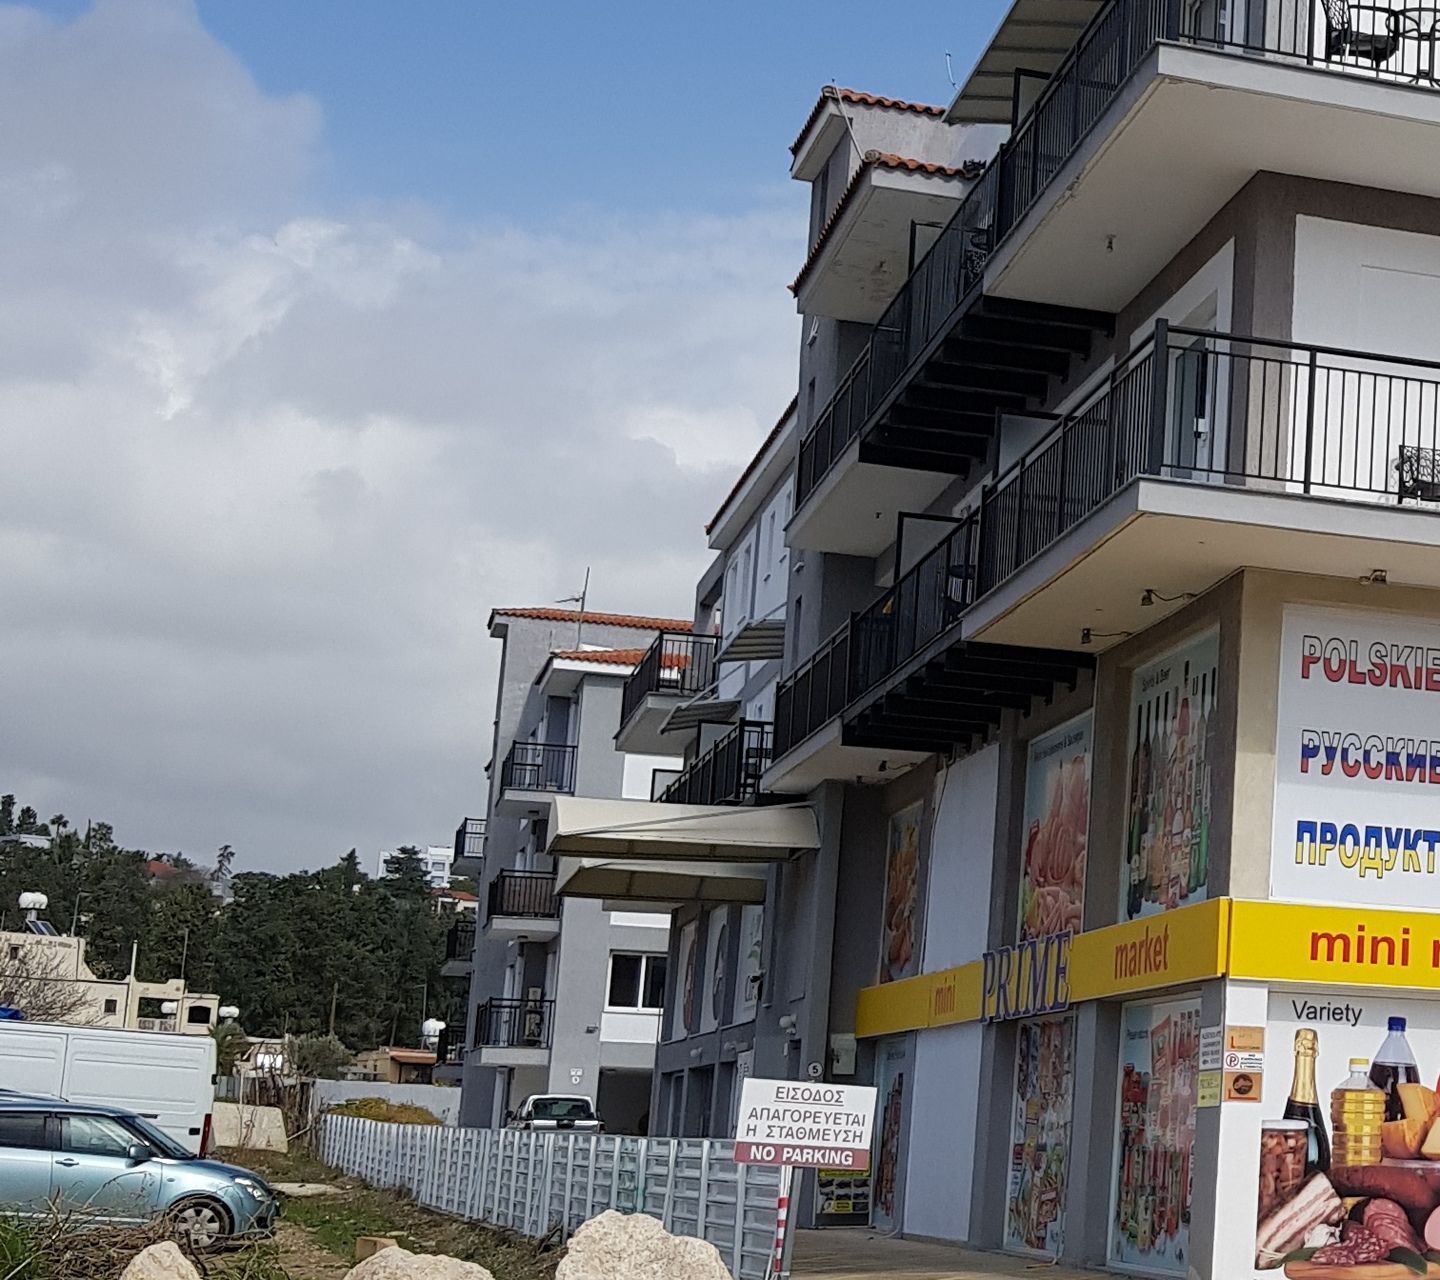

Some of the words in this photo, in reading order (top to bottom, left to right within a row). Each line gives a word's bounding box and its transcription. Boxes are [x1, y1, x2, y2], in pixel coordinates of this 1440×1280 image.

[1310, 924, 1411, 967] mini
[934, 975, 956, 1016] mini
[980, 929, 1073, 1023] PRIME
[1114, 924, 1170, 980] market
[1292, 1000, 1363, 1027] Variety
[812, 1065, 818, 1074] 5
[775, 1086, 845, 1104] ΕΙΣΟΔΟΣ
[748, 1107, 866, 1127] ΑΠΑΓΟΡΕΥΕΤΑΙ
[766, 1125, 864, 1144] ΣΤΑΘΜΕΥΣΗ
[750, 1145, 776, 1161] NO
[782, 1147, 854, 1165] PARKING
